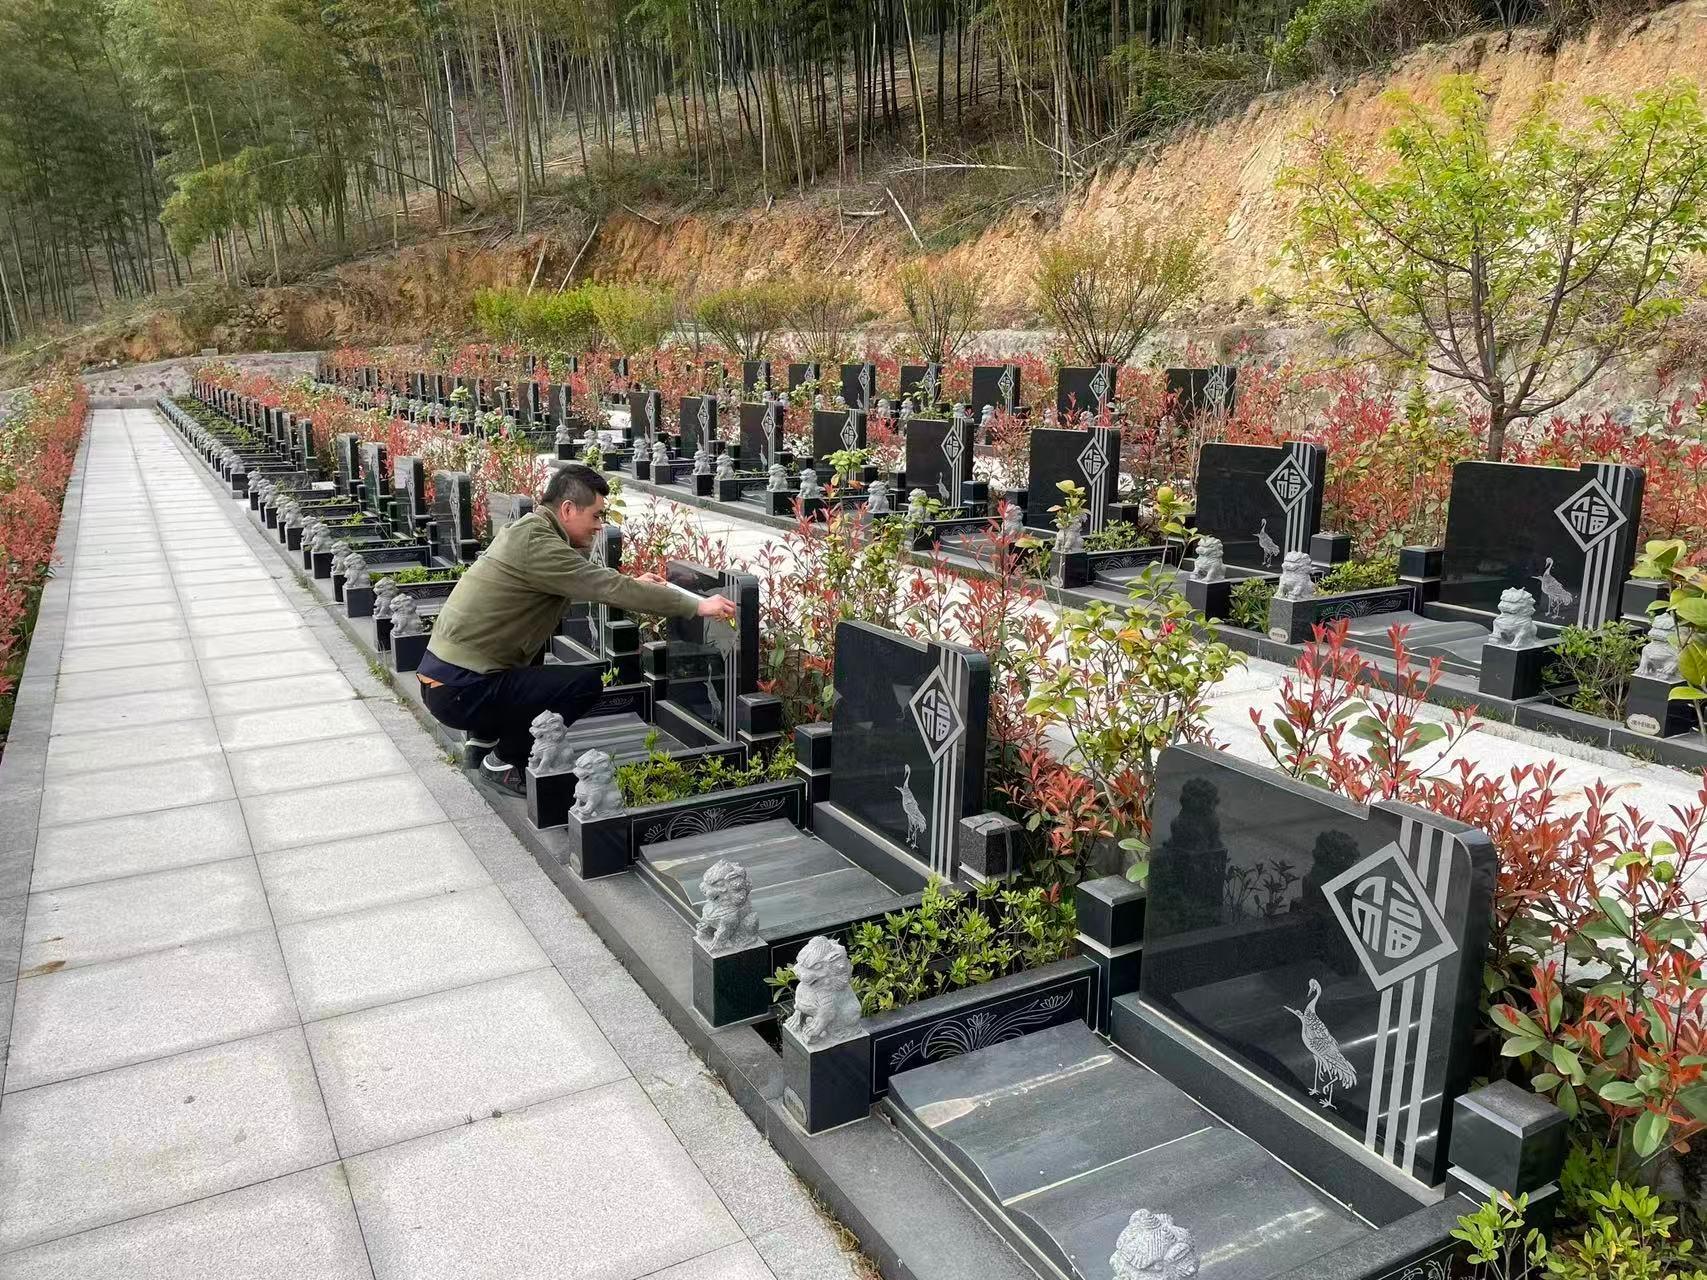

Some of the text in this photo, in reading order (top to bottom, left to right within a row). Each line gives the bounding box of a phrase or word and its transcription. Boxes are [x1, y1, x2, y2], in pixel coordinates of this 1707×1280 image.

[1084, 449, 1102, 475] 福
[1271, 468, 1303, 500] 福
[1571, 497, 1610, 535] 福
[921, 689, 952, 742] 福
[1351, 875, 1422, 959] 福
